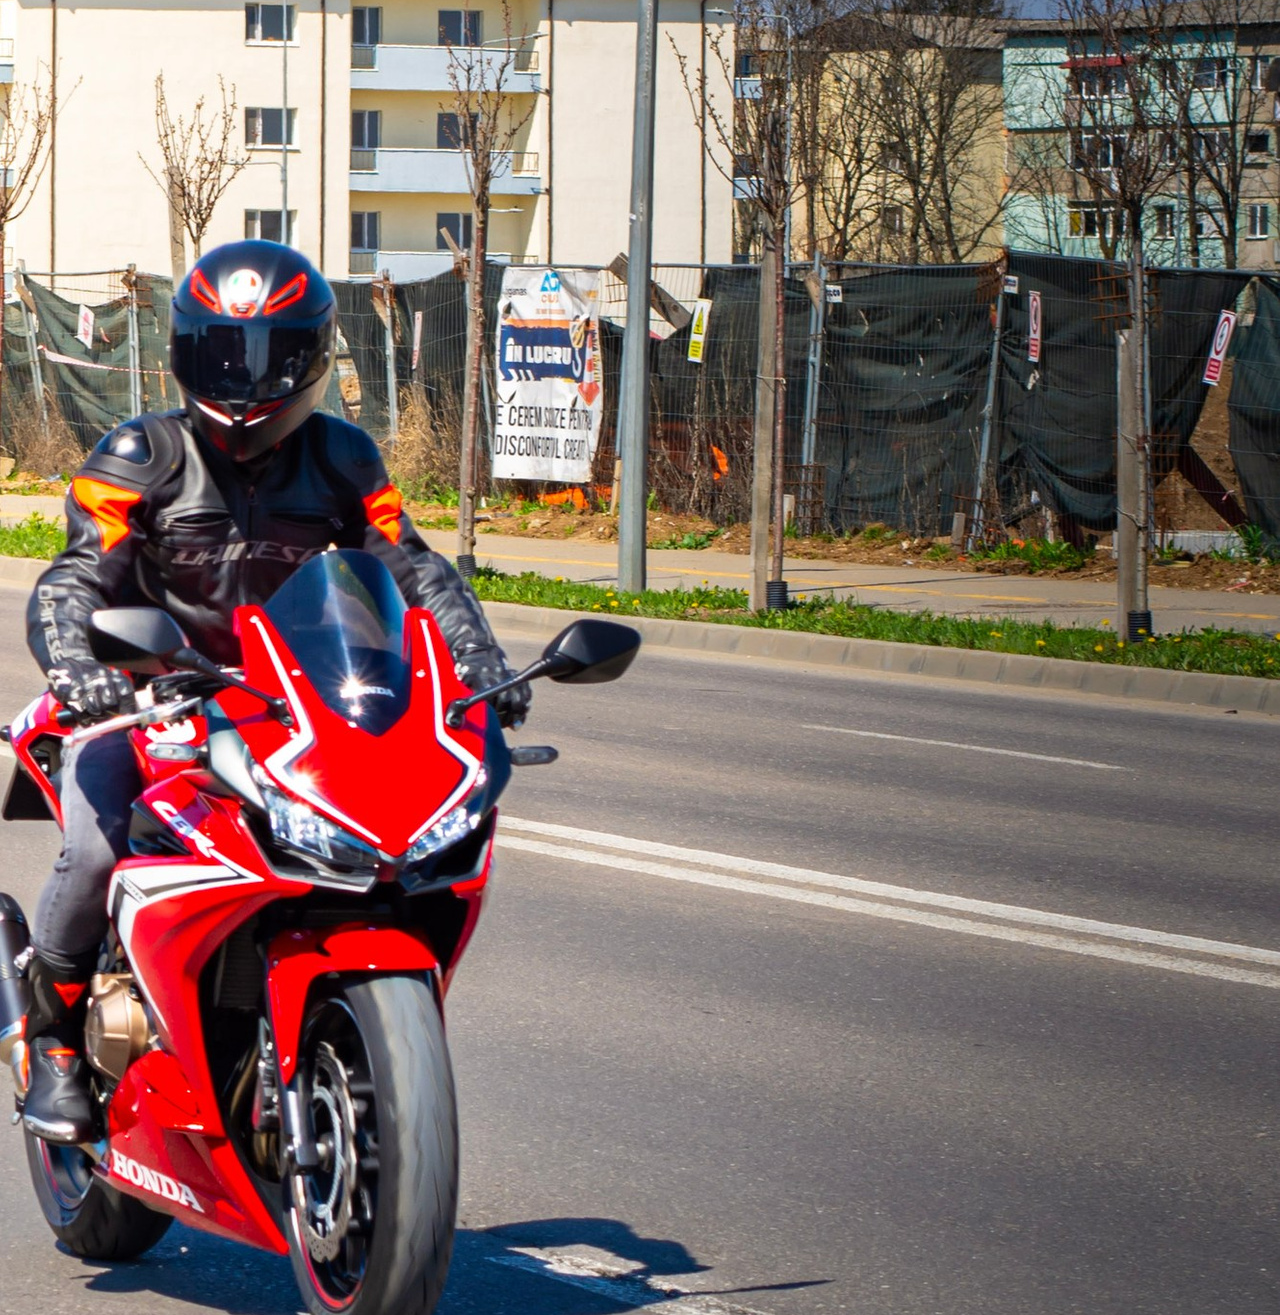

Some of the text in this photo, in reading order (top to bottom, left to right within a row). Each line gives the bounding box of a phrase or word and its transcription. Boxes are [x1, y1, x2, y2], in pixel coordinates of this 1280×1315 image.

[505, 337, 572, 366] ÎN LUCRU
[508, 405, 543, 428] CEREM
[110, 1147, 206, 1214] HONDA
